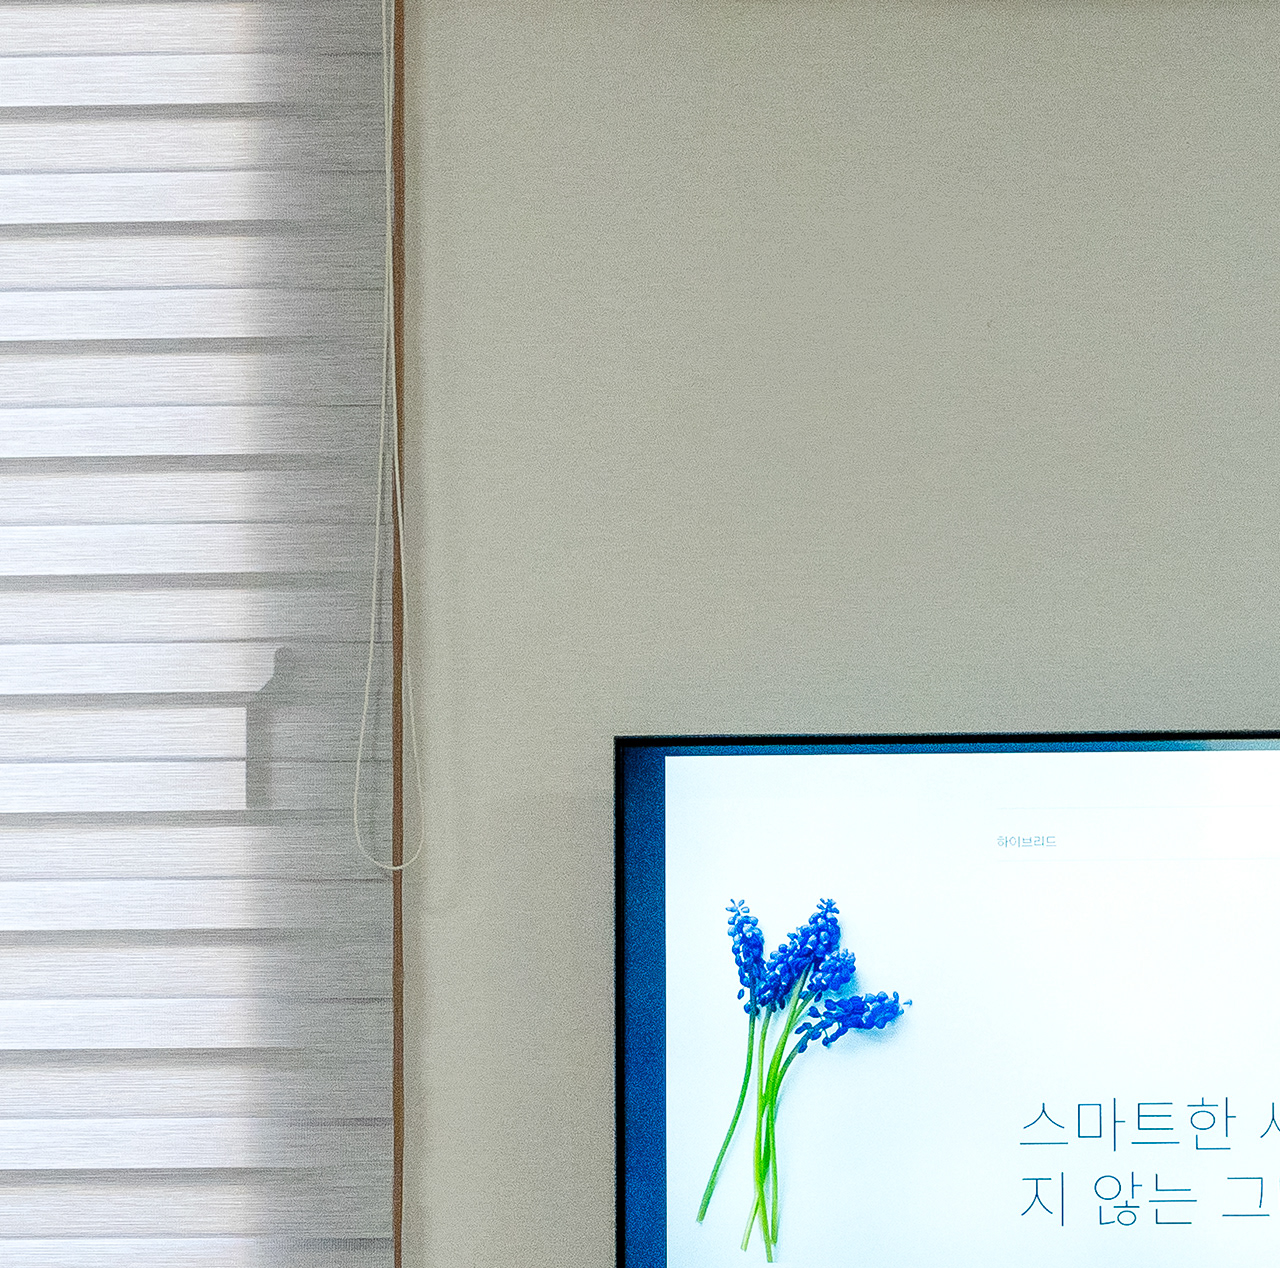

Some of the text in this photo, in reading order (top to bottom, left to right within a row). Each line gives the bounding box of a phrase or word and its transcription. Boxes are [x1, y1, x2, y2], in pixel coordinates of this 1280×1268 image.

[996, 833, 1058, 849] 하이브리드
[1018, 1094, 1238, 1154] 스마트한
[1019, 1170, 1067, 1228] 지
[1093, 1168, 1198, 1228] 않는
